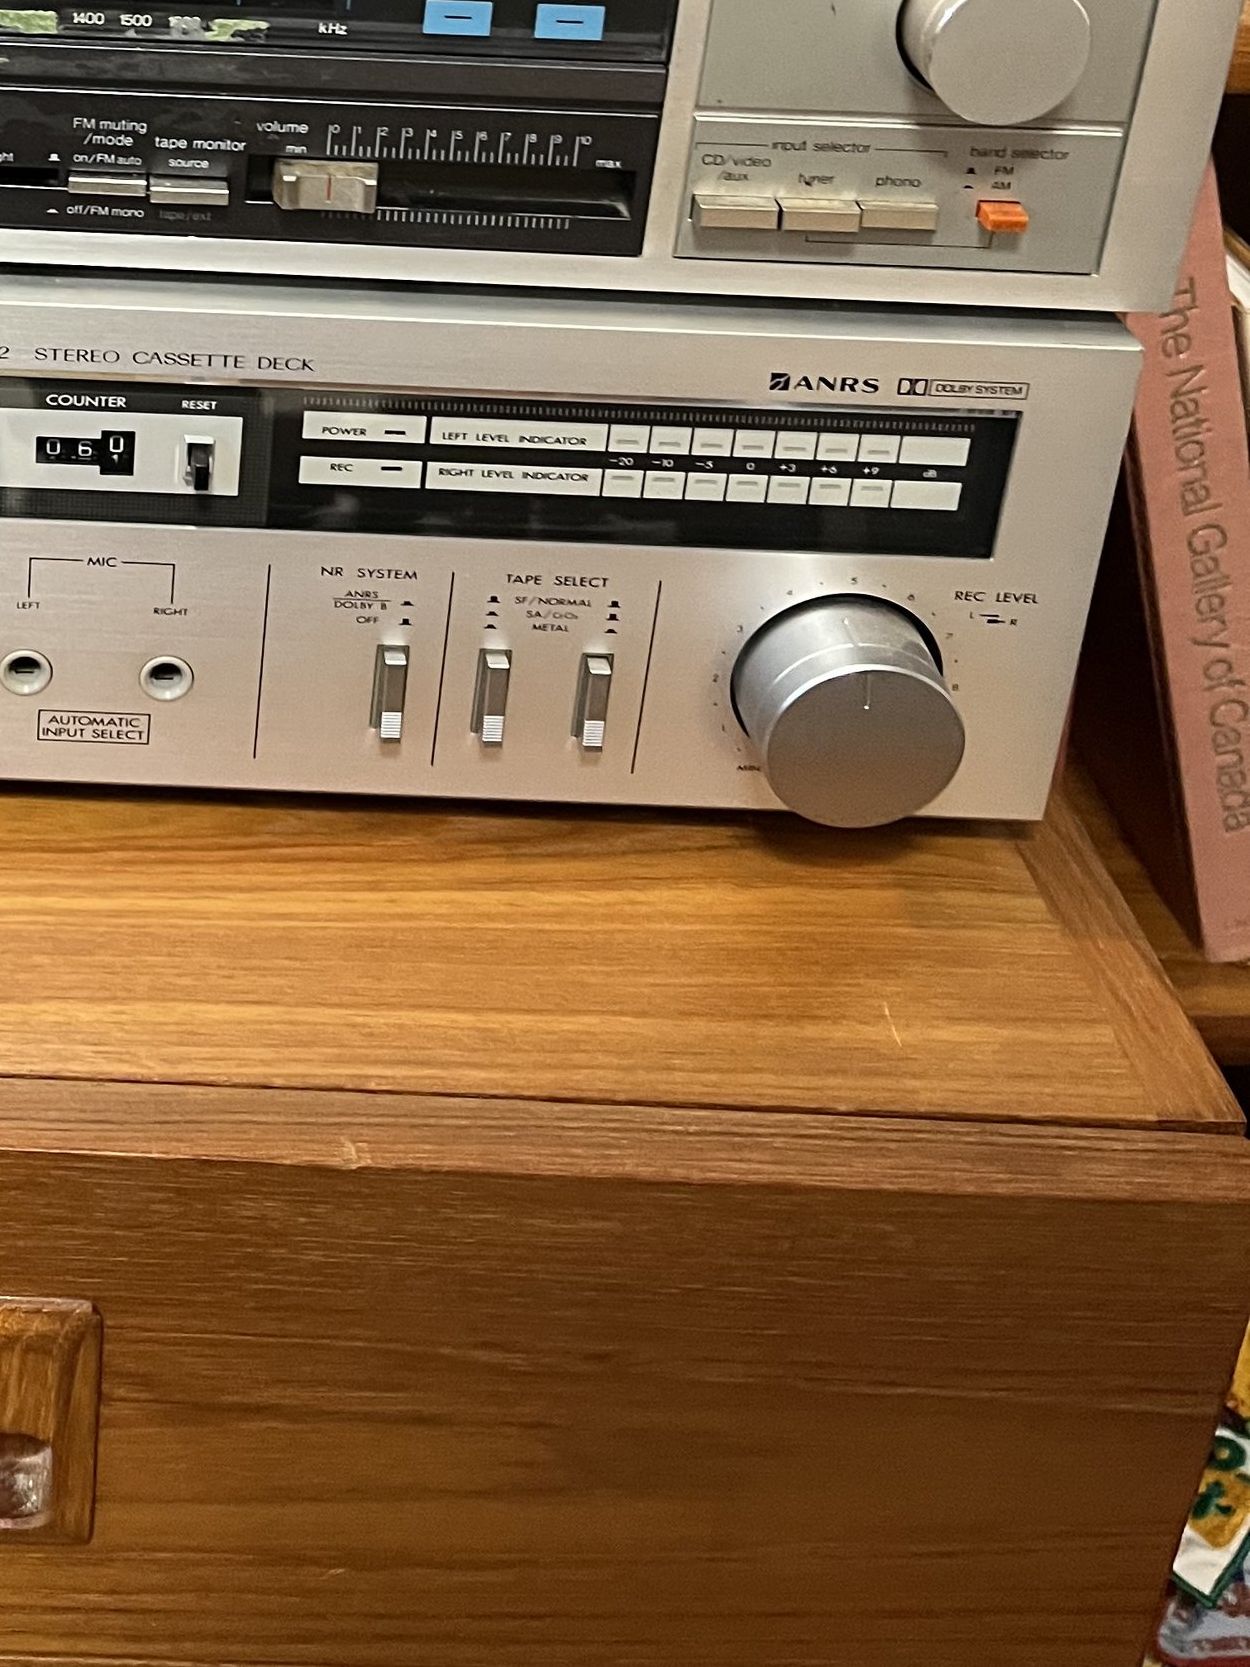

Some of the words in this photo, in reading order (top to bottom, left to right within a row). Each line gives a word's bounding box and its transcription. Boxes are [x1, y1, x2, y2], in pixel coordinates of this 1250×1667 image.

[72, 12, 105, 25] 1400
[119, 14, 152, 27] 1500
[318, 22, 348, 35] kHz
[73, 117, 96, 130] FM
[100, 119, 147, 134] muting
[256, 120, 309, 134] volume
[155, 137, 188, 151] tape
[193, 138, 247, 152] monitor
[772, 140, 807, 152] input
[812, 141, 872, 154] selector
[285, 144, 307, 154] min
[595, 159, 622, 169] max
[969, 146, 1007, 159] band
[1010, 148, 1070, 161] selector
[168, 157, 210, 169] source
[798, 172, 835, 185] tuner
[874, 175, 921, 188] phono
[1158, 275, 1199, 360] The
[34, 347, 120, 364] STEREO
[132, 350, 246, 369] CASSETTE
[257, 355, 316, 372] DECK
[793, 376, 880, 394] ANRS
[935, 383, 975, 394] DOLBY
[975, 384, 1023, 396] SYSTEM
[45, 394, 127, 408] COUNTER
[181, 399, 218, 411] RESET
[321, 425, 367, 437] POWER
[442, 431, 468, 442] LEFT
[475, 433, 510, 444] LEVEL
[518, 435, 587, 447] INDICATOR
[1165, 363, 1224, 517] National
[330, 462, 354, 472] REC
[438, 467, 474, 478] RIGHT
[481, 469, 515, 480] LEVEL
[521, 470, 590, 483] INDICATOR
[86, 556, 118, 567] MIC
[321, 566, 344, 577] NR
[356, 567, 418, 581] SYSTEM
[506, 573, 542, 586] TAPE
[553, 574, 609, 588] SELECT
[1185, 522, 1233, 648] Gallery
[344, 590, 380, 600] ANRS
[953, 590, 986, 602] REC
[995, 592, 1039, 605] LEVEL
[16, 601, 41, 610] LEFT
[152, 607, 189, 617] RIGHT
[333, 600, 374, 610] DOLBY
[355, 615, 380, 625] OFF
[532, 623, 569, 633] METAL
[1203, 658, 1247, 693] of
[47, 715, 142, 728] AUTOMATIC
[41, 727, 85, 738] INPUT
[91, 728, 145, 740] SELECT
[1208, 698, 1250, 833] Canada
